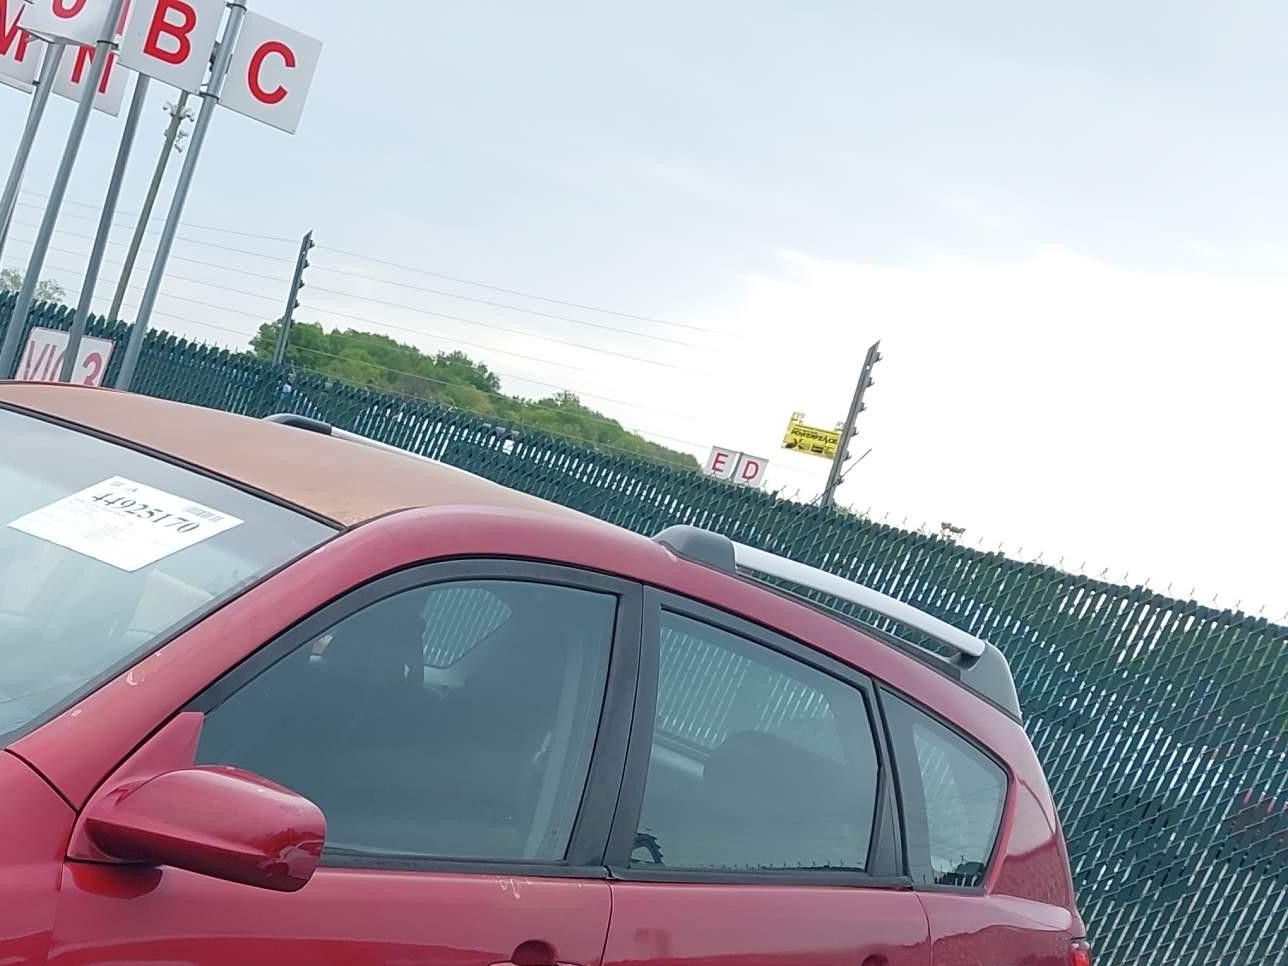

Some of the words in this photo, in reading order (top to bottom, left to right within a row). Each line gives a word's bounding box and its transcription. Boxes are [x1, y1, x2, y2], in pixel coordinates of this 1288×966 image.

[143, 0, 197, 65] B
[248, 41, 296, 104] C
[712, 452, 729, 473] E
[742, 460, 759, 480] D
[92, 492, 201, 533] 44925170
